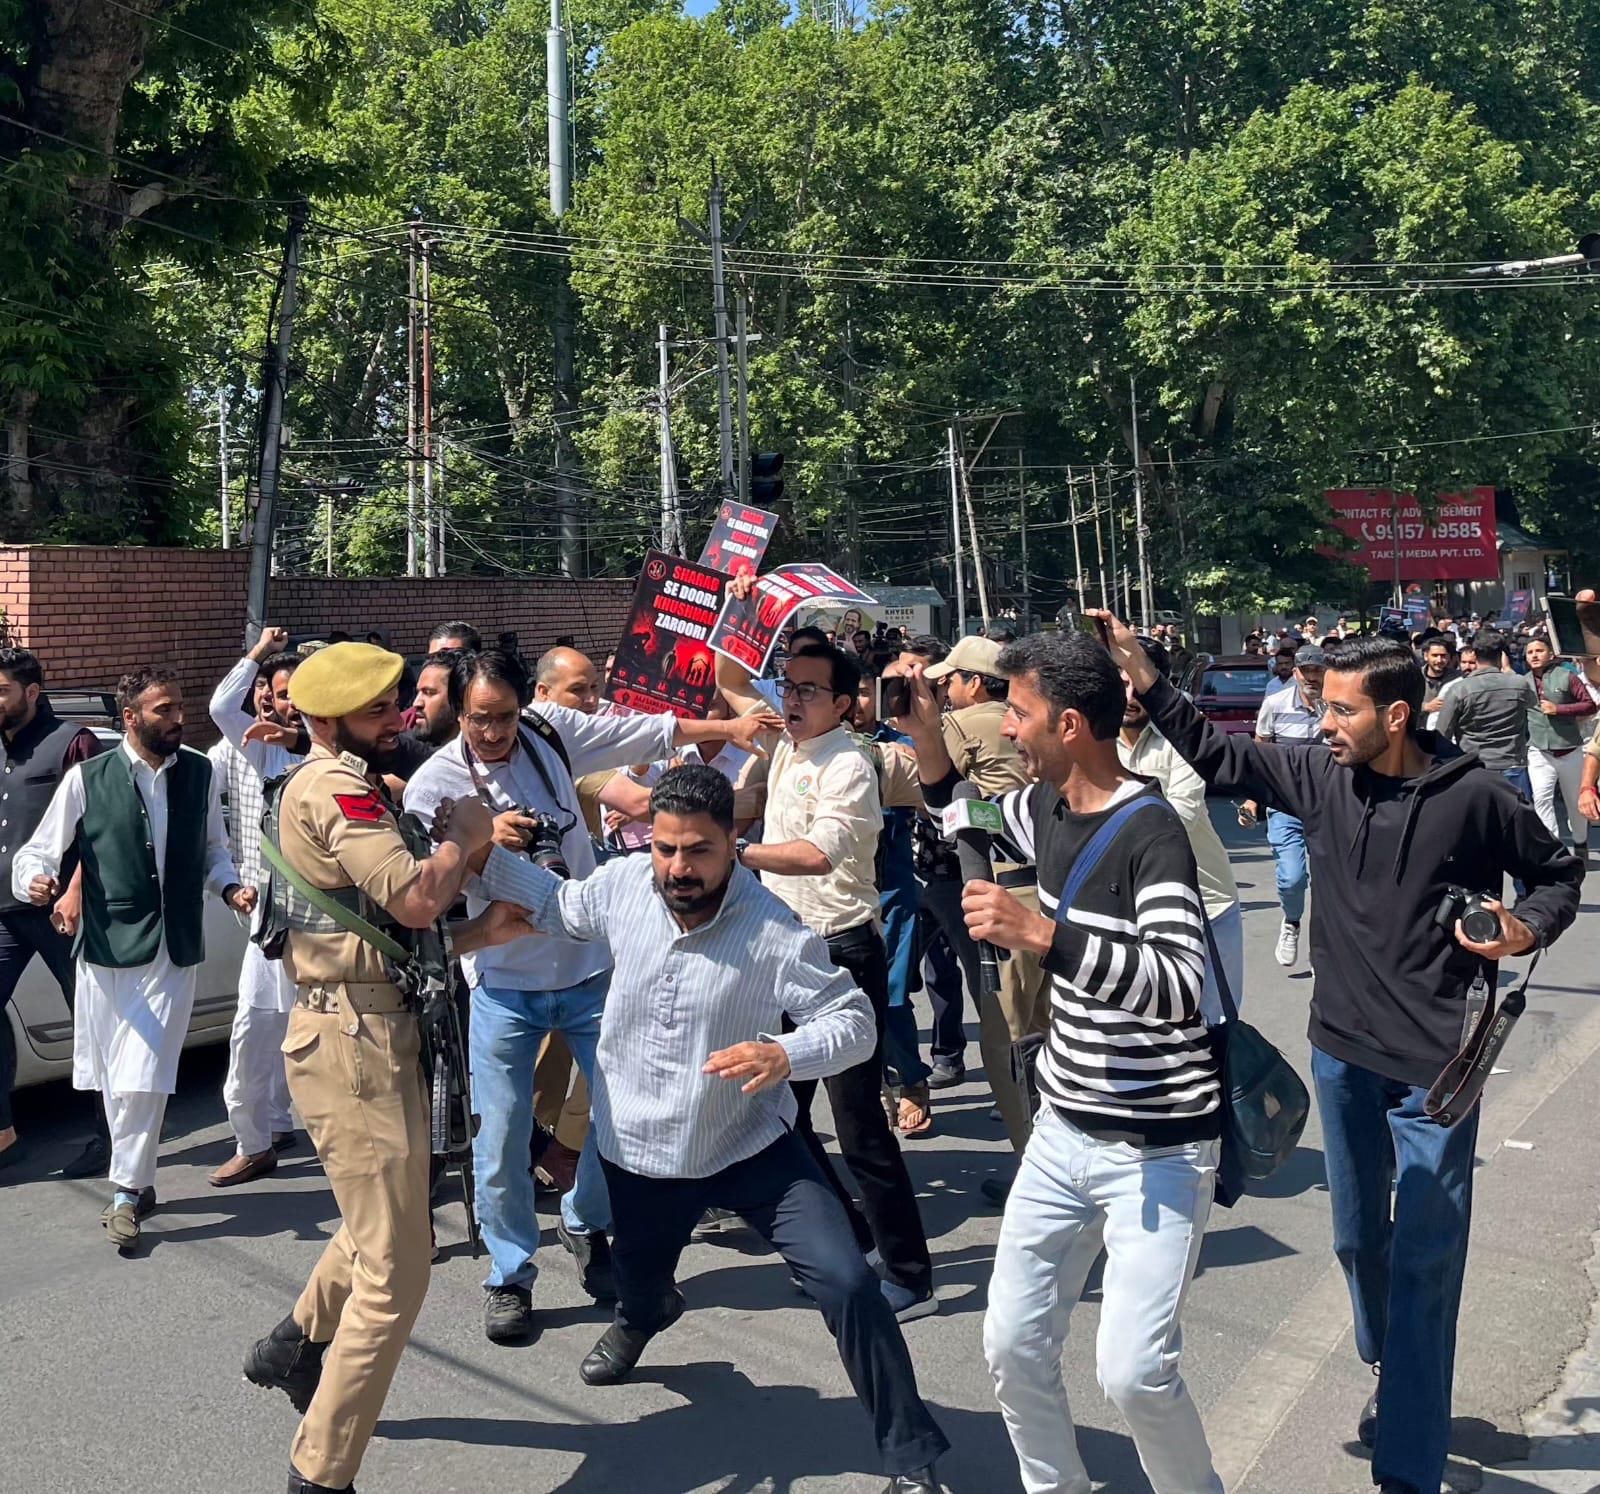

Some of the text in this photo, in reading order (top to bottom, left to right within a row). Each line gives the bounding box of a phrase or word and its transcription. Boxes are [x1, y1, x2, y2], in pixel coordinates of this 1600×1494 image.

[1432, 521, 1482, 539] 19585
[1406, 549, 1438, 558] MEDIA
[1440, 548, 1461, 557] PVT.
[1463, 548, 1485, 557] LTD.
[672, 565, 721, 592] SHARAB
[663, 580, 718, 611] SE DOORI,
[885, 608, 914, 616] KHYBER
[654, 612, 707, 641] ZAROORI
[1493, 1016, 1508, 1038] EOS
